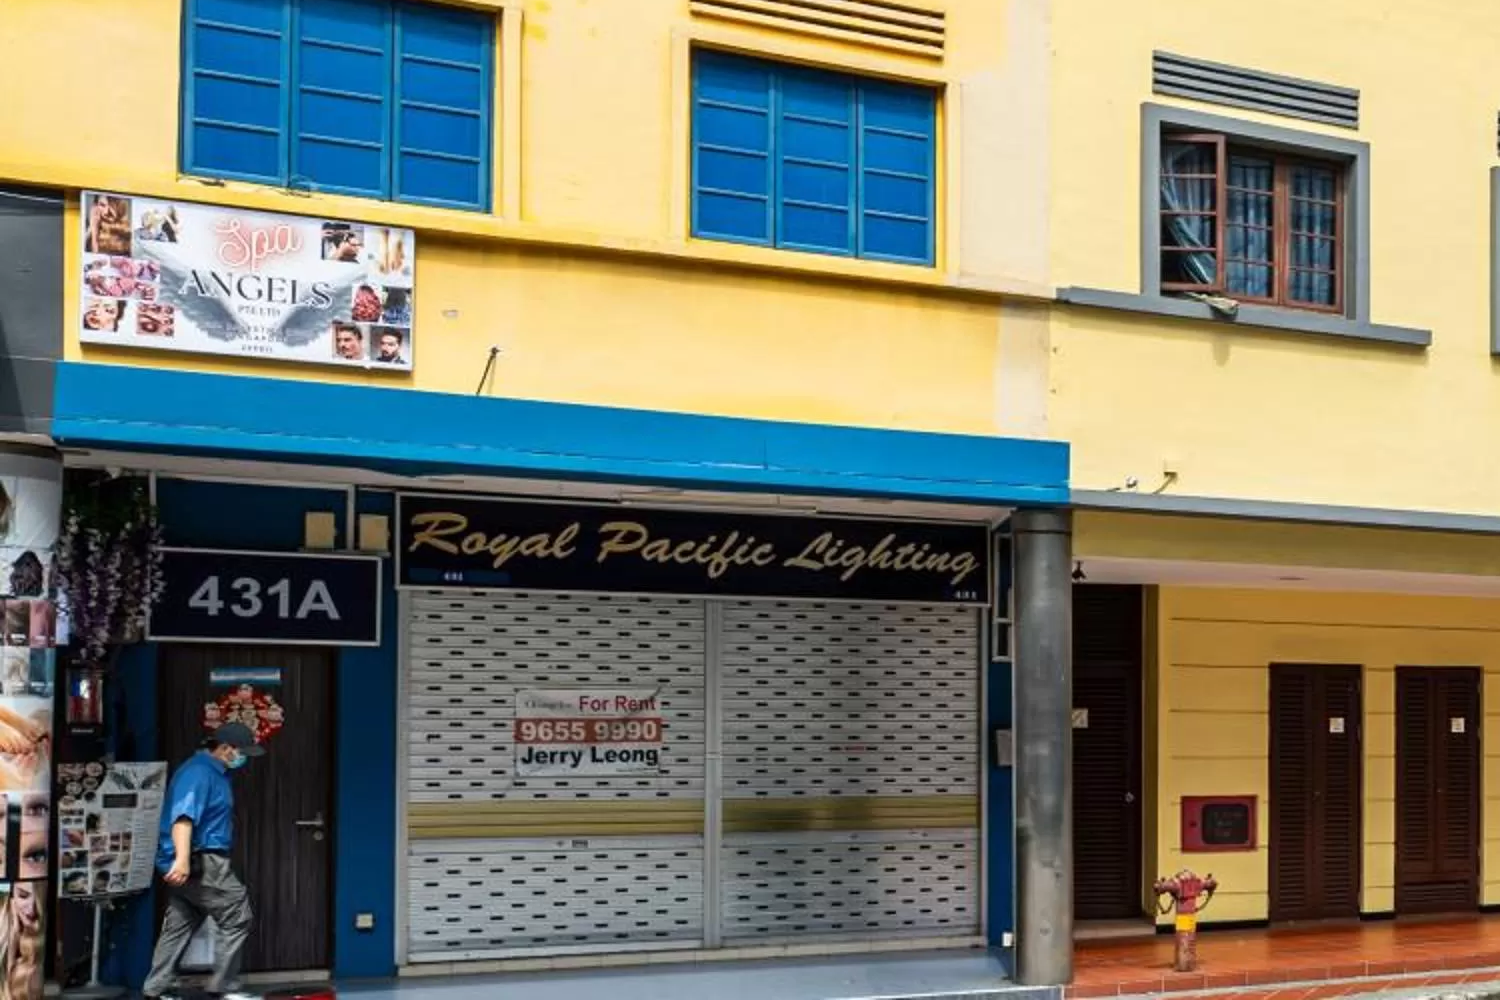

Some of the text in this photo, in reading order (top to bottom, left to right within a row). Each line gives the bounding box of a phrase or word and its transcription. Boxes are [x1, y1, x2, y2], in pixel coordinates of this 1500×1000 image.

[216, 219, 301, 270] Spa
[178, 269, 334, 309] ANGELS
[409, 511, 980, 585] Royal Pacific Lighting
[188, 575, 341, 620] 431A
[579, 696, 612, 712] For
[615, 695, 656, 711] Rent
[520, 720, 658, 741] 9655 9990
[521, 745, 659, 768] Jerry Leong
